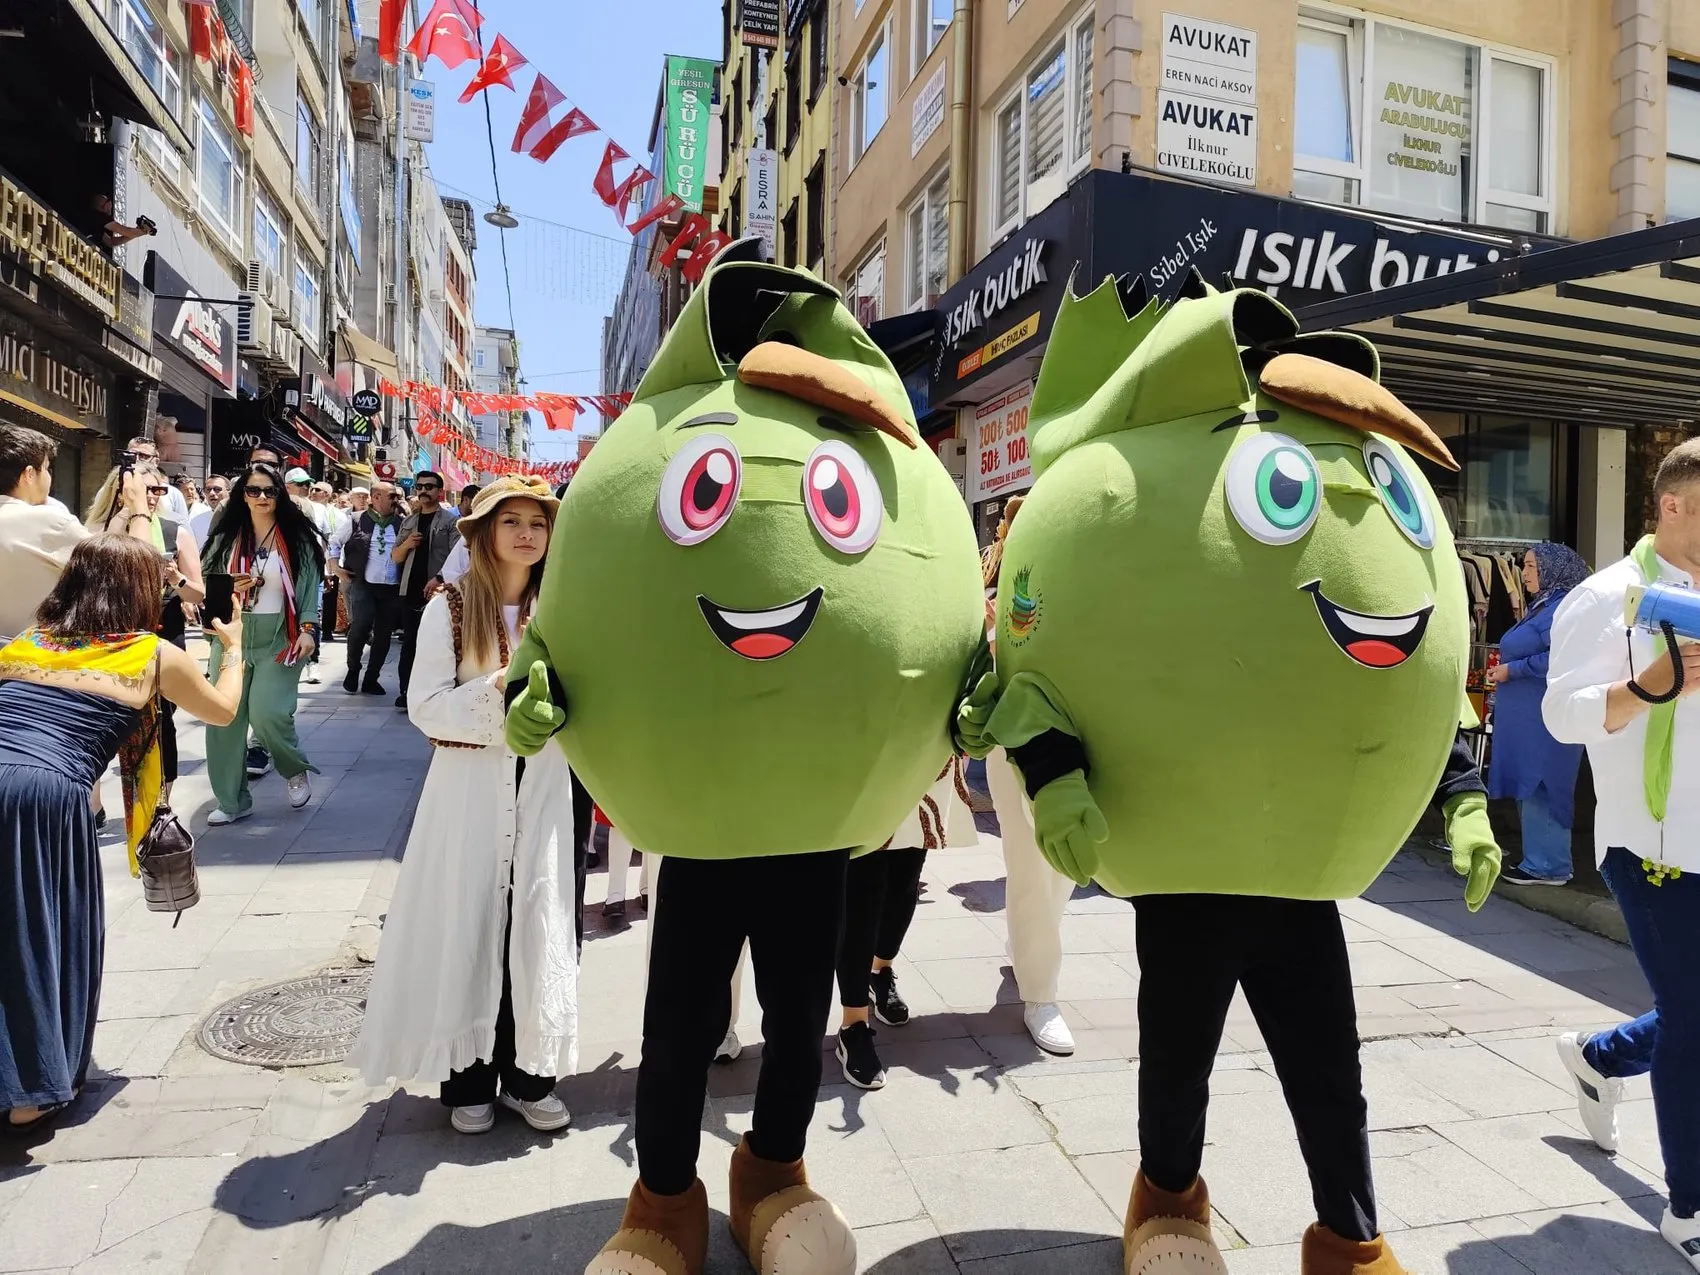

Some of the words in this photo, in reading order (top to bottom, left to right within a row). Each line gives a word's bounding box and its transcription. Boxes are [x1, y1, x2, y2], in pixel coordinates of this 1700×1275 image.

[743, 20, 762, 30] ÇELİK
[763, 23, 778, 32] YAPI
[744, 9, 778, 21] KONTEYNER
[1169, 24, 1251, 58] AVUKAT
[1166, 68, 1192, 83] EREN
[1194, 74, 1218, 88] NACİ
[1220, 80, 1253, 95] AKSOY
[1384, 82, 1464, 115] AVUKAT
[1162, 100, 1254, 136] AVUKAT
[1380, 108, 1467, 139] ARABULUCU
[676, 89, 699, 198] SÜRÜCÜ
[1188, 134, 1229, 156] İlknur
[1403, 133, 1442, 154] İLKNUR
[1158, 150, 1254, 180] CİVELEKOĞLU
[1387, 152, 1457, 176] CİVELEKOĞLU
[758, 169, 768, 210] ESRA
[0, 174, 47, 262] ECE
[1150, 242, 1190, 289] Sibel
[1193, 217, 1218, 254] Işık
[983, 238, 1046, 319] butik
[46, 350, 107, 418] İLETİŞİM
[356, 395, 378, 406] MAD
[230, 432, 261, 447] MAD
